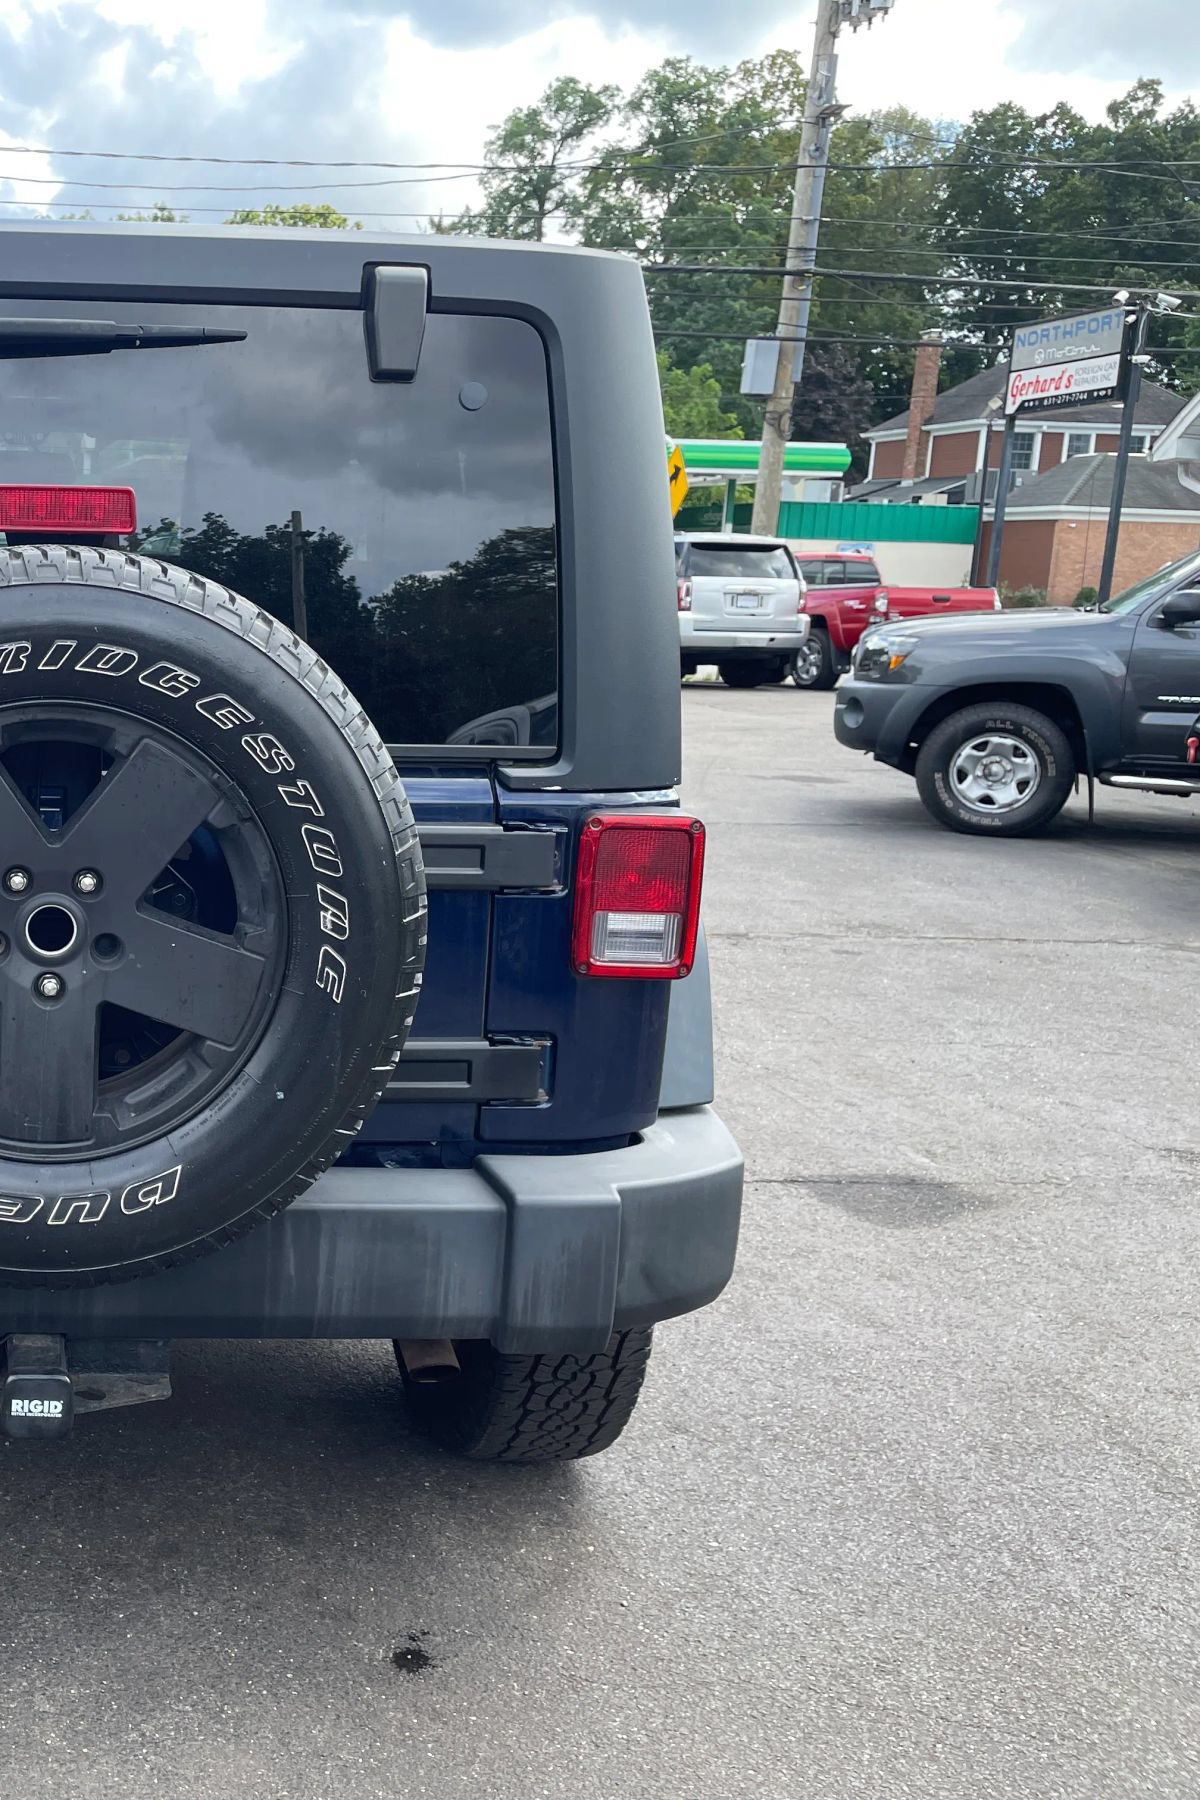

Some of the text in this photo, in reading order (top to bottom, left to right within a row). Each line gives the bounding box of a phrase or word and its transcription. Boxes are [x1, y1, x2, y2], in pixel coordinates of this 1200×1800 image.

[1016, 312, 1124, 348] NORTHPORT
[1011, 367, 1074, 405] Gerhard's
[11, 1399, 63, 1413] RIGID
